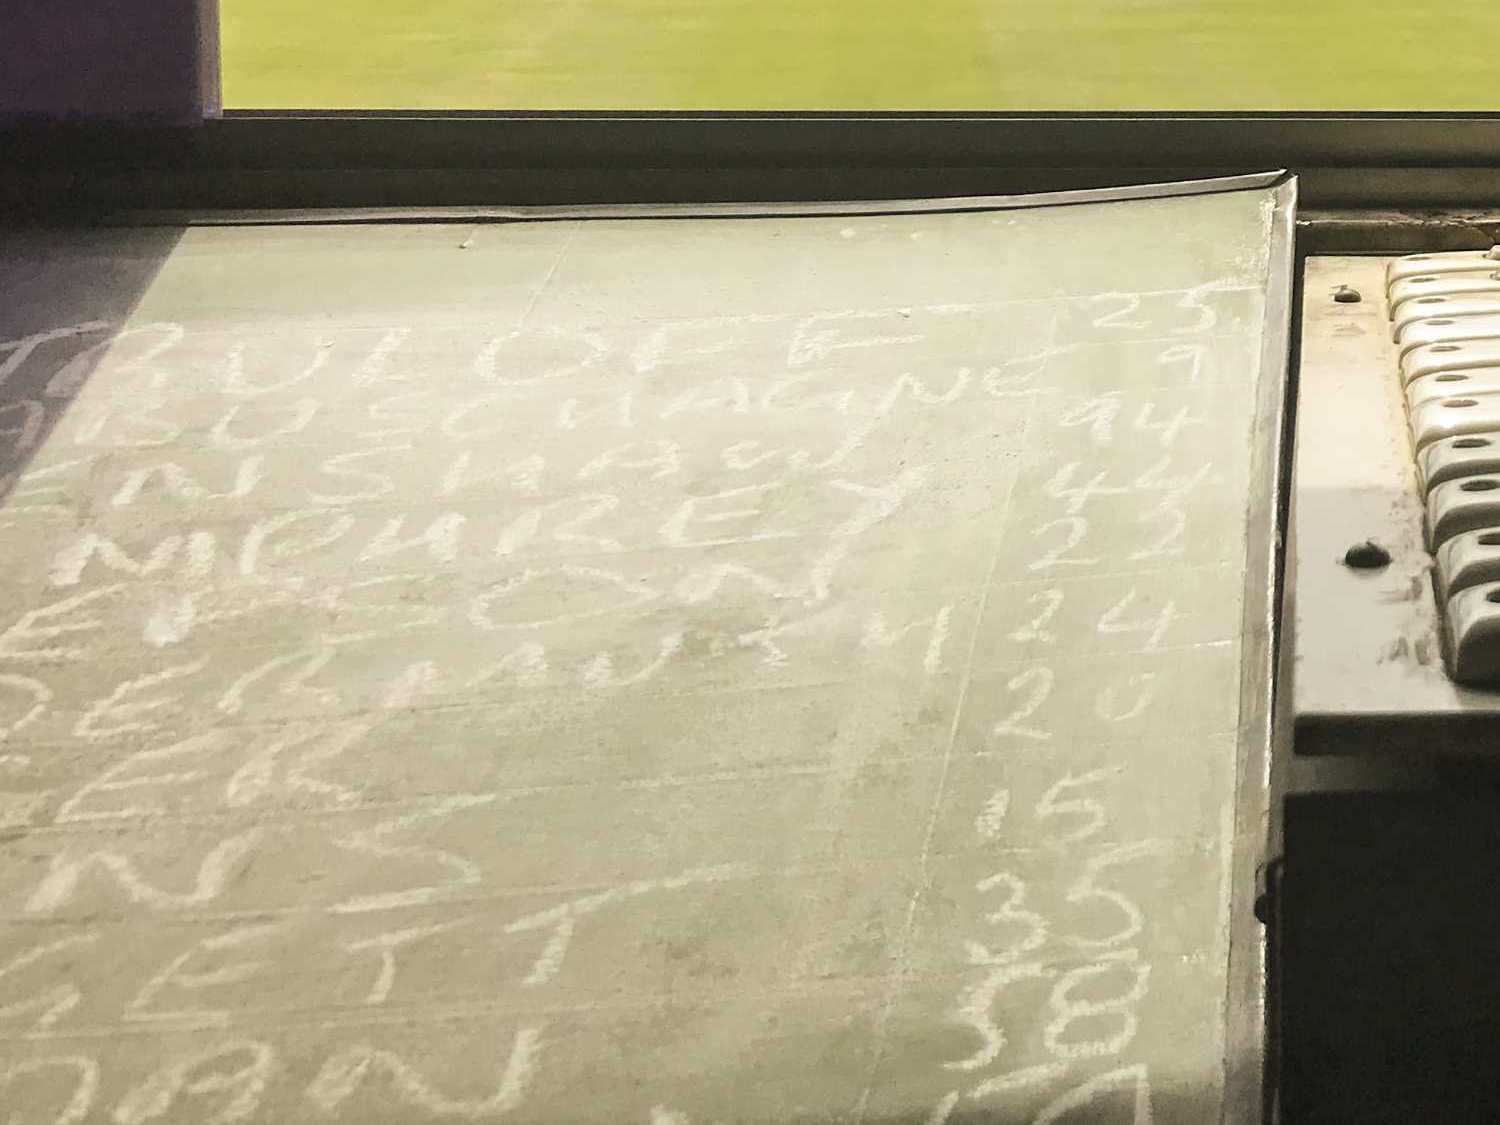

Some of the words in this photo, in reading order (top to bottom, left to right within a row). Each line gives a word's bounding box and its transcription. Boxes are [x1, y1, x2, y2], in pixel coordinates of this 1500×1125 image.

[1089, 287, 1222, 333] 25
[1030, 513, 1188, 572] 22
[1010, 588, 1196, 652] 24
[994, 666, 1157, 740] 20
[963, 838, 1172, 963] 35
[938, 961, 1152, 1071] 58
